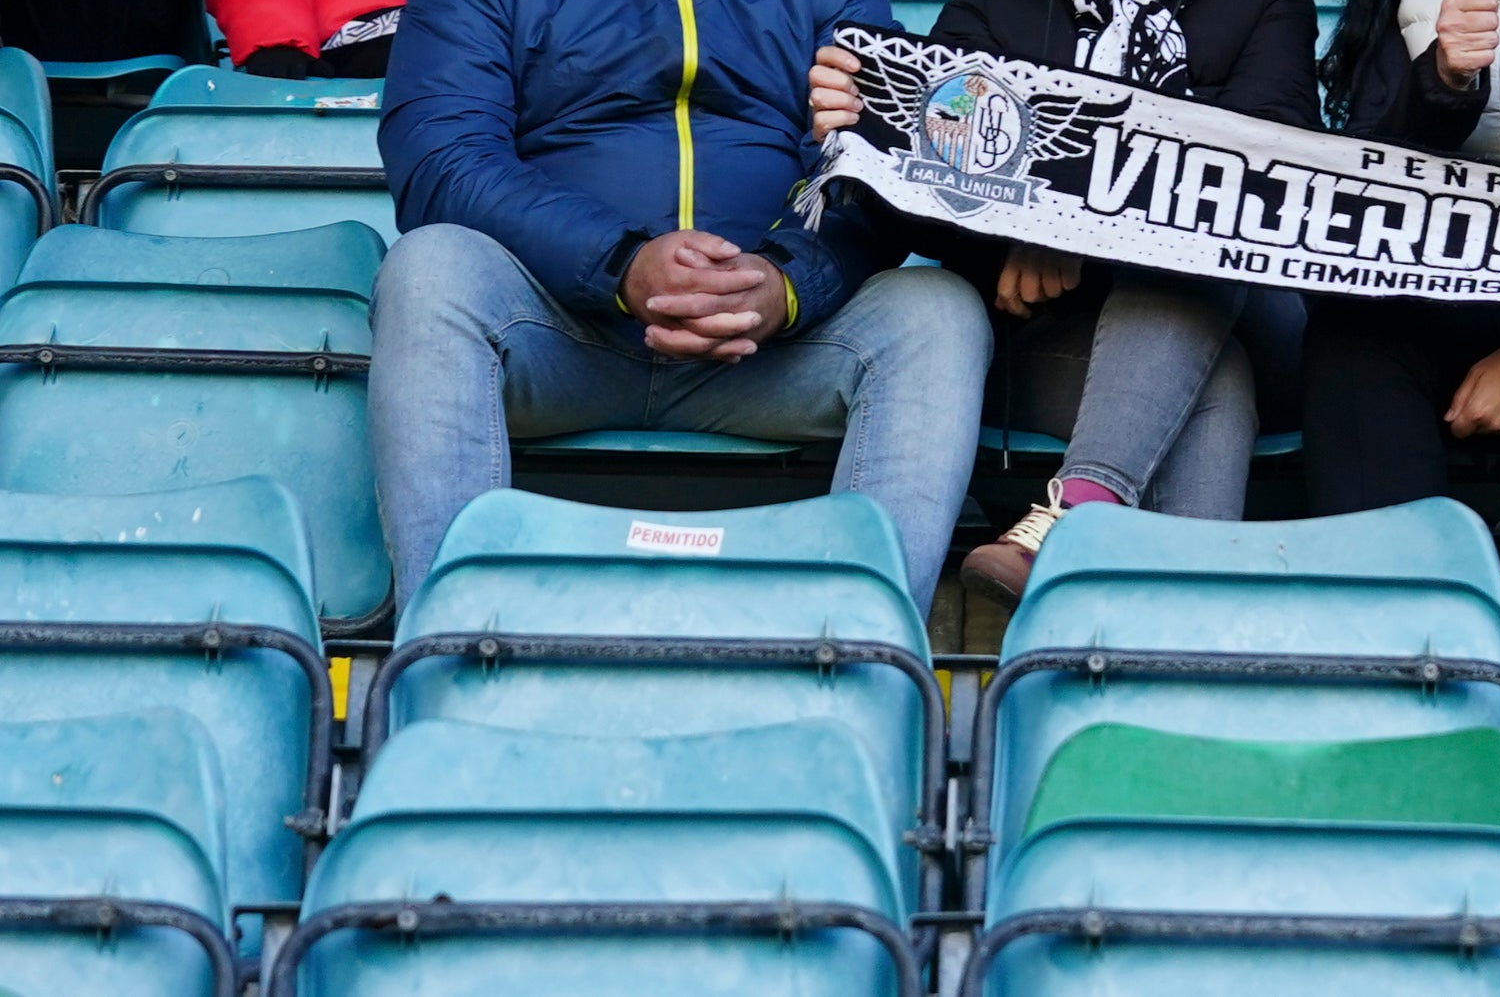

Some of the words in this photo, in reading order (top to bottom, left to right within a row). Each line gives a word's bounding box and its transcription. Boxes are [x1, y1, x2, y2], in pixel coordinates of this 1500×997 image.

[911, 167, 956, 187] HALA
[960, 179, 1016, 201] UNION
[1217, 247, 1270, 274] NO
[630, 526, 719, 548] PERMITIDO
